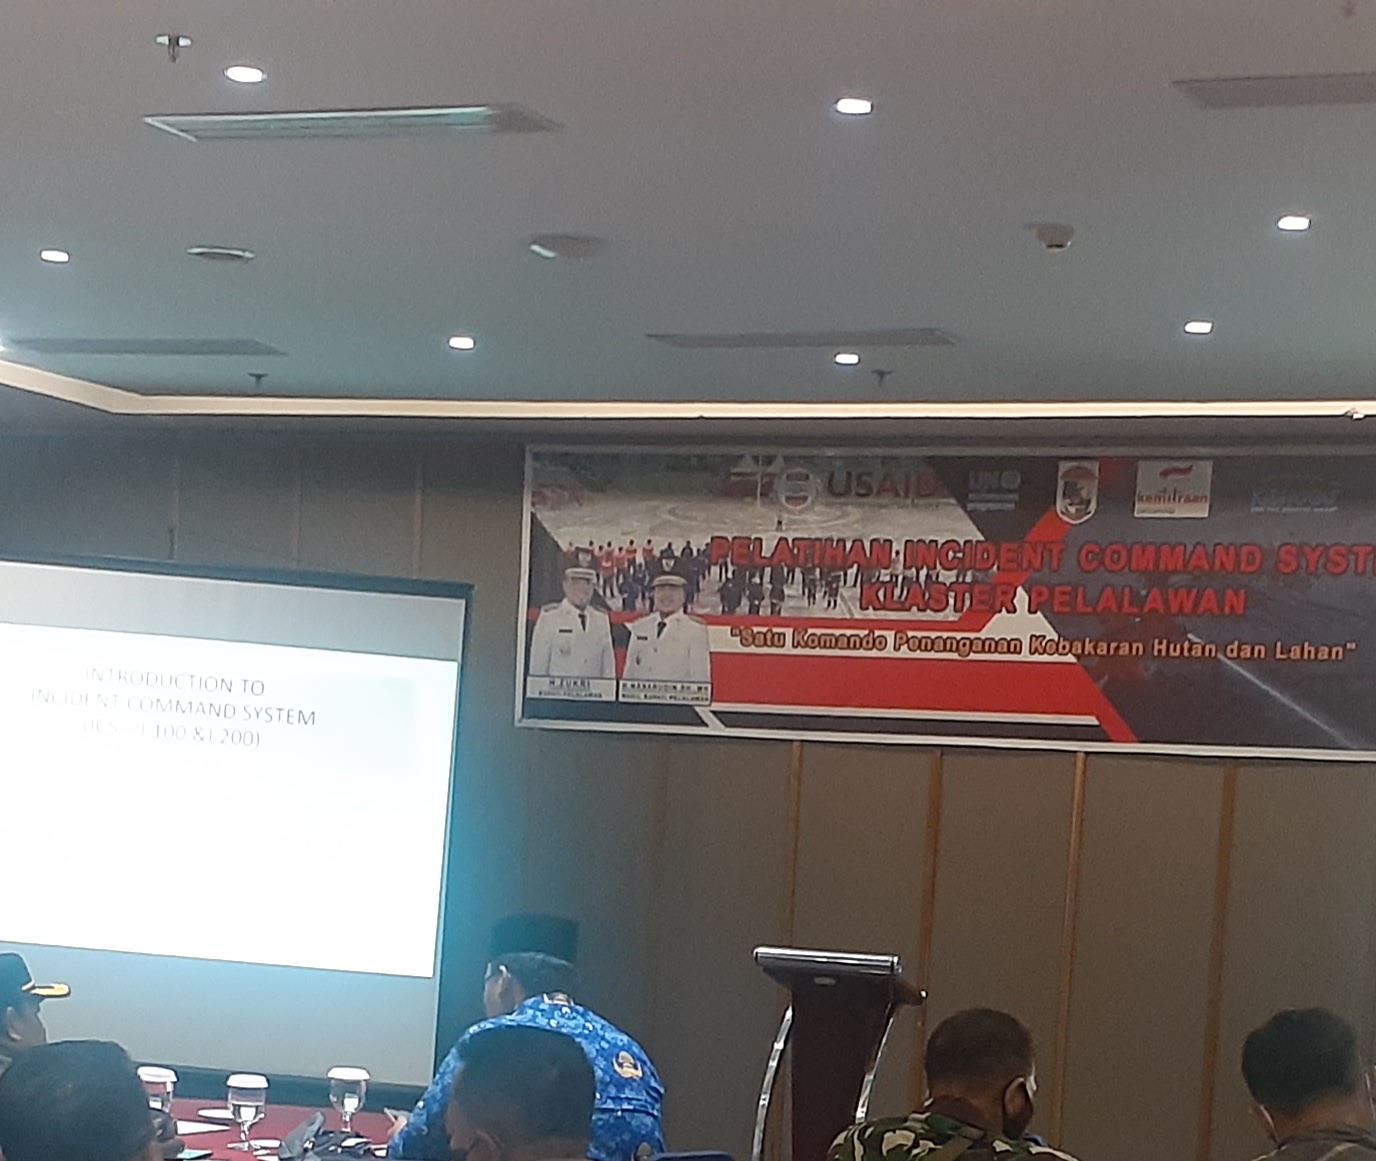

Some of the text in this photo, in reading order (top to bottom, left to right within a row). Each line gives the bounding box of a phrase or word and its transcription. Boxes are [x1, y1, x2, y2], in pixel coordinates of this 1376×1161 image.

[710, 535, 893, 569] PELATIHAN
[904, 539, 1065, 572] INCIDENT
[1078, 541, 1263, 574] COMMAND
[860, 582, 1248, 616] KLASTER PELALAWAN
[792, 628, 888, 651] Komando
[893, 631, 1023, 656] Penanganan
[1029, 634, 1144, 657] Kebakaran
[1153, 638, 1218, 659] Hutan
[1225, 639, 1267, 660] dan
[1274, 641, 1358, 662] Lahan"
[85, 667, 265, 697] INTRODUCTION TO
[31, 688, 317, 726] INCIDENT COMMAND SYSTEM
[155, 723, 187, 742] 100
[220, 728, 262, 750] 200)
